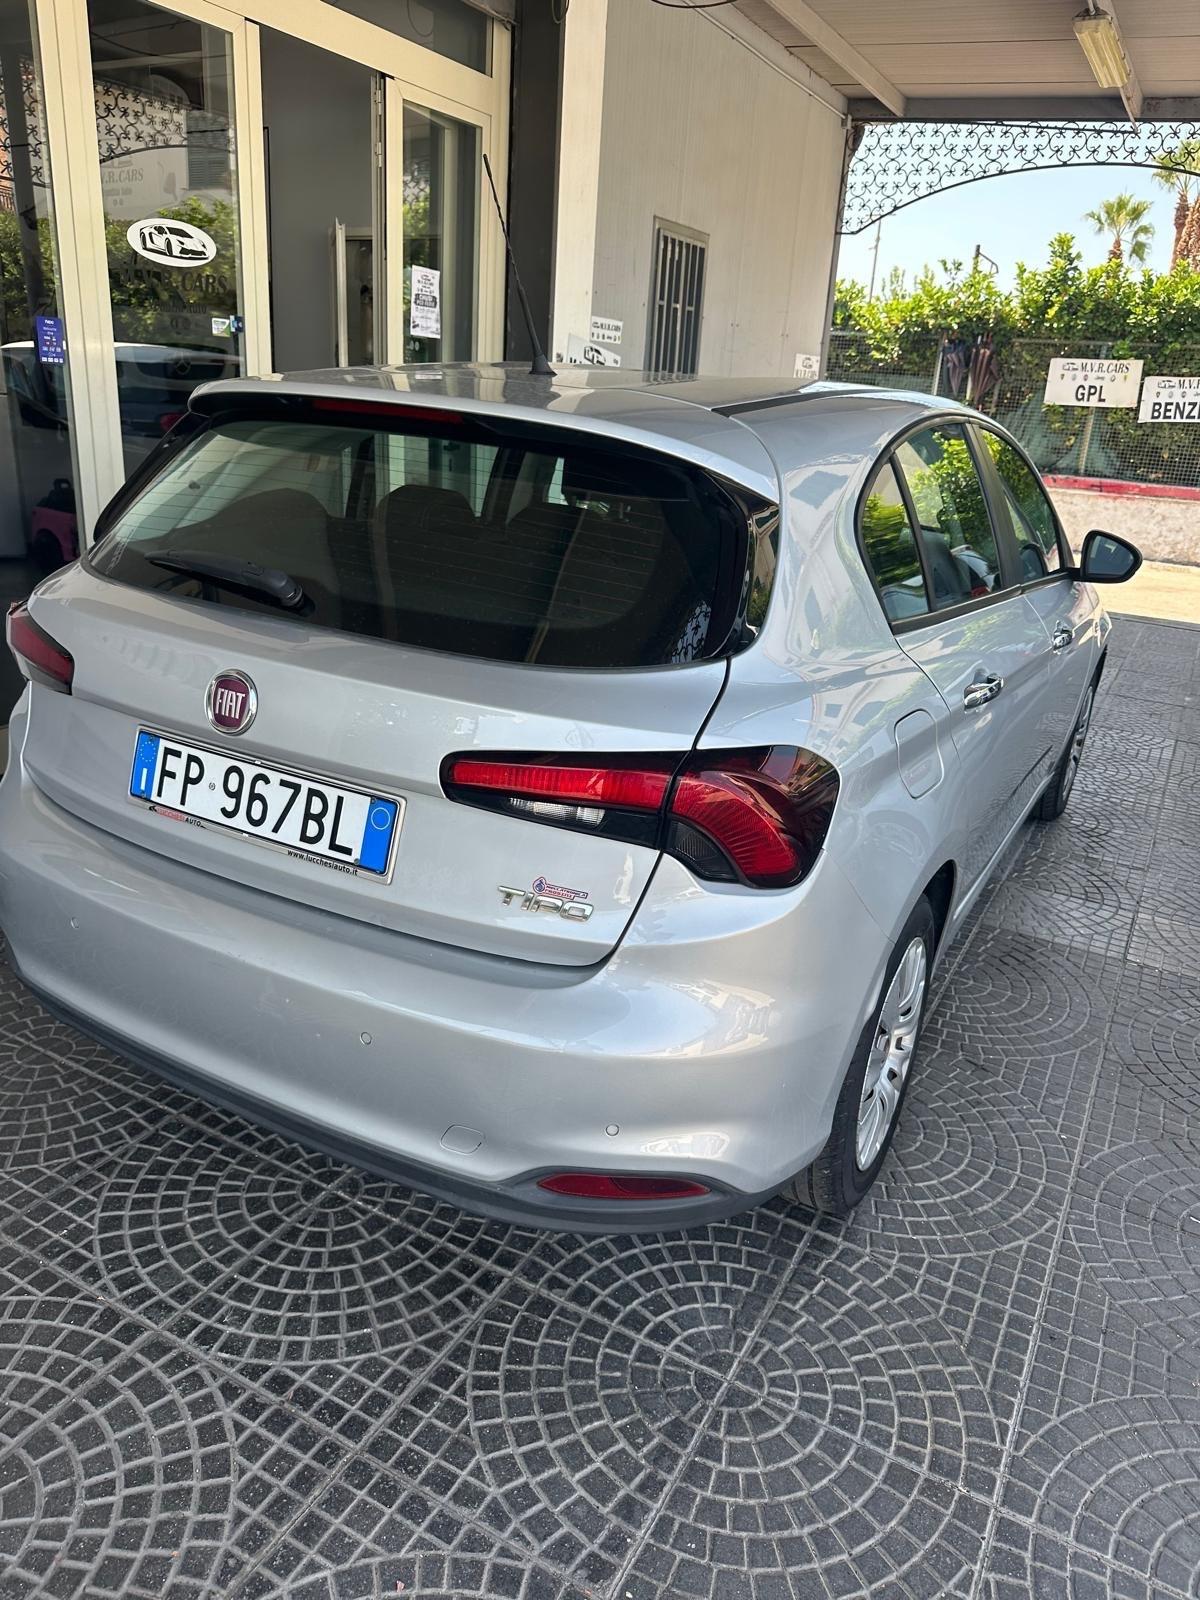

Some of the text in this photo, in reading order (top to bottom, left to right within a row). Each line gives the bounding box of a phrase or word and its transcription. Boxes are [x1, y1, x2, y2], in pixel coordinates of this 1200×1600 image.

[1081, 361, 1131, 374] M.V.R.CARS
[1075, 384, 1106, 402] GPL
[215, 687, 246, 719] FIAT
[156, 746, 353, 857] FP 967BL
[287, 849, 358, 876] www.lucchesiauto.it
[497, 885, 594, 922] TIPO
